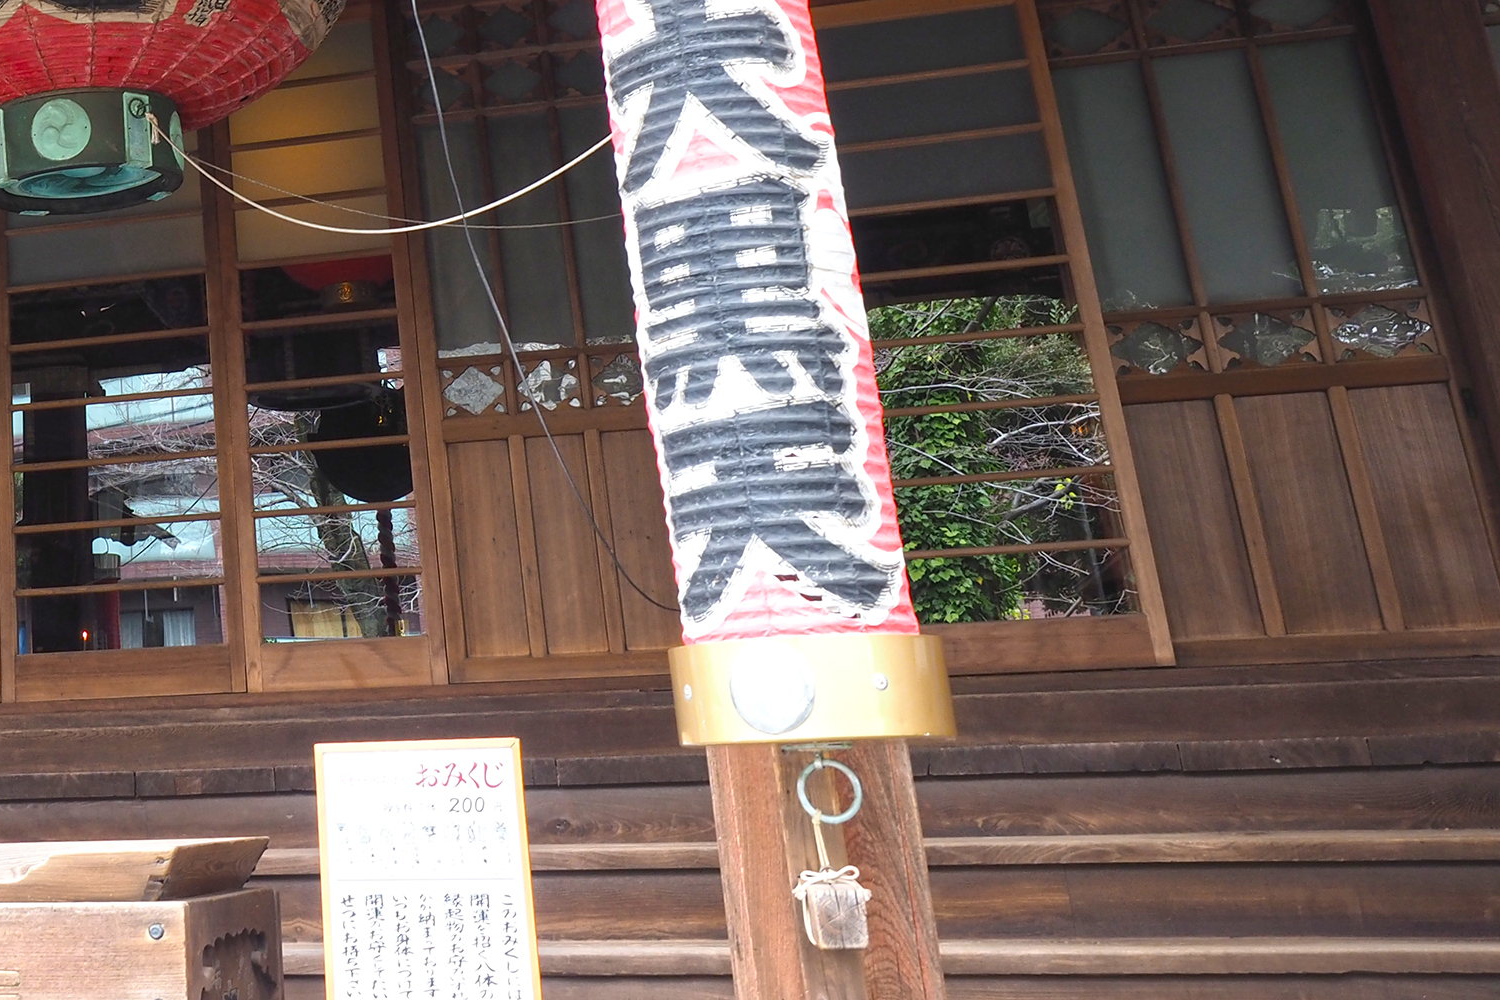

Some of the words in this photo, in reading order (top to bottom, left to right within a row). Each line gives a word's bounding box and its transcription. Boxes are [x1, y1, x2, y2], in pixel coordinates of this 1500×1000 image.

[415, 761, 503, 789] おみくじ
[449, 797, 485, 813] 200
